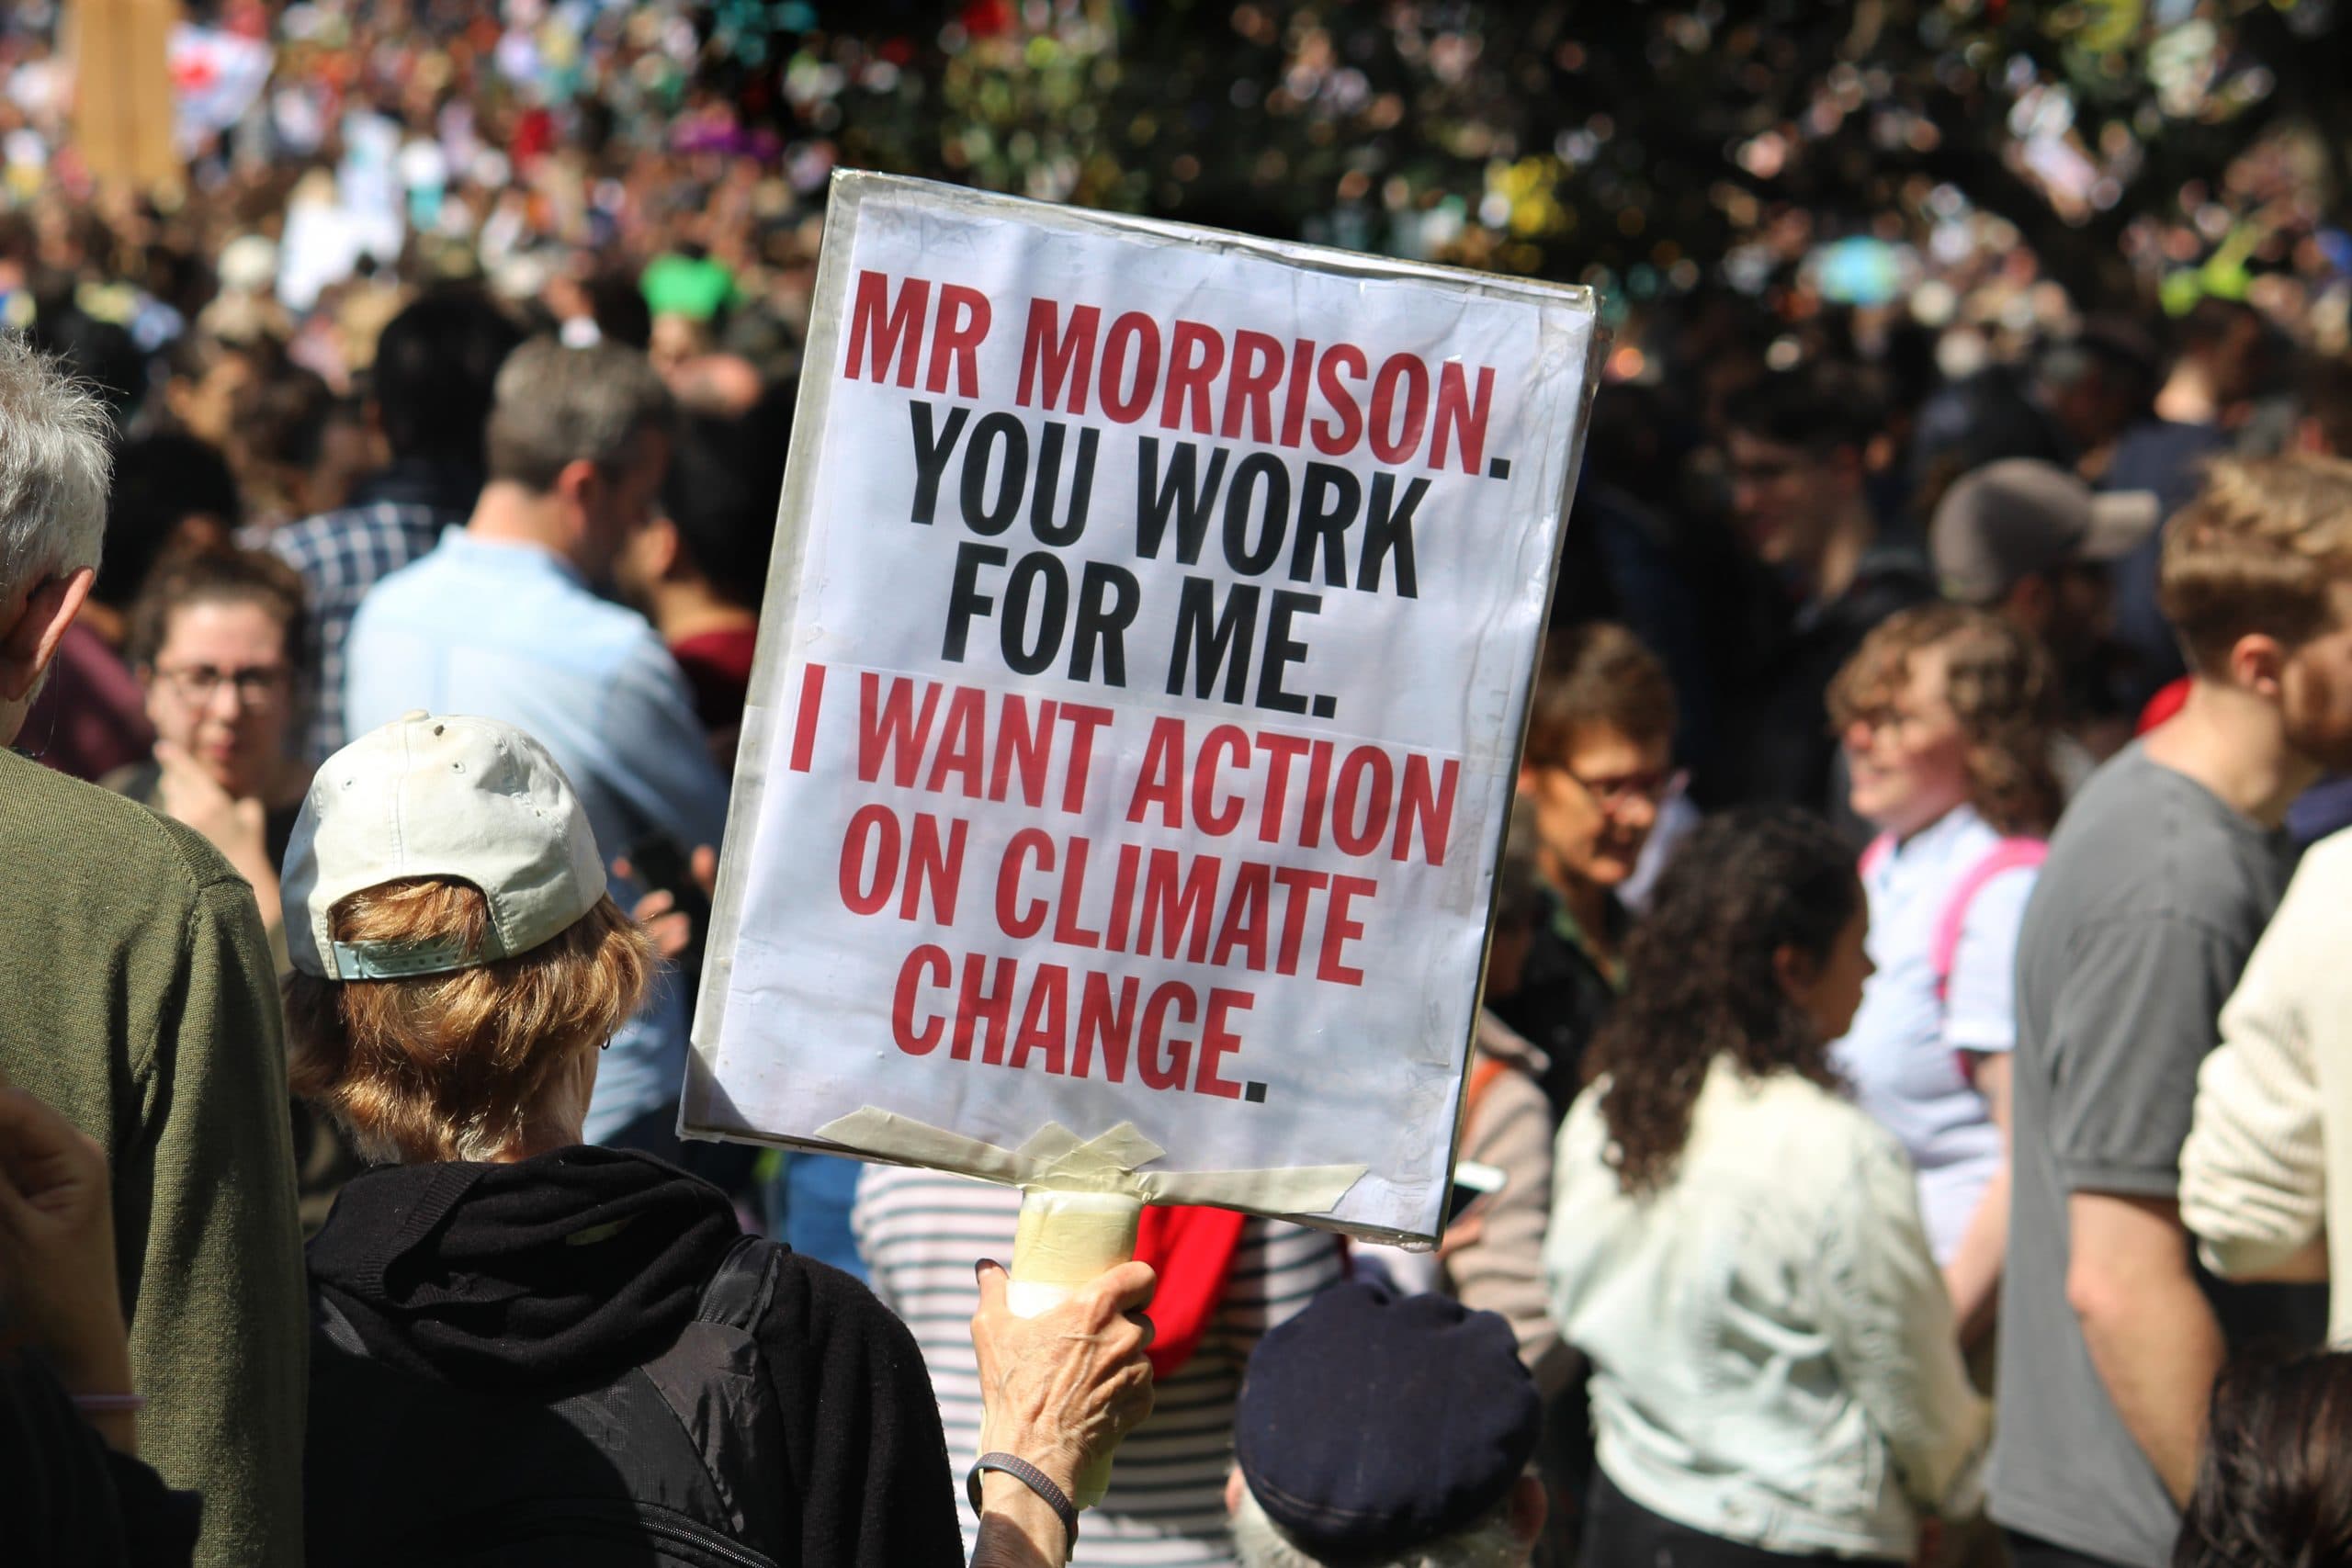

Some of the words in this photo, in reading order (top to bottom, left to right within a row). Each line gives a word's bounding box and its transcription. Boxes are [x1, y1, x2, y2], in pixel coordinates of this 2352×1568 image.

[844, 270, 991, 400] MR
[1015, 297, 1511, 480] MORRISON.
[909, 400, 1101, 547] YOU
[1136, 435, 1431, 599] WORK
[941, 541, 1141, 688] FOR
[1165, 575, 1338, 719] ME.
[790, 663, 826, 773] I
[858, 671, 1114, 814] WANT
[1125, 716, 1460, 867] ACTION
[839, 804, 969, 927] ON
[995, 828, 1378, 987] CLIMATE
[892, 943, 1268, 1103] CHANGE.
